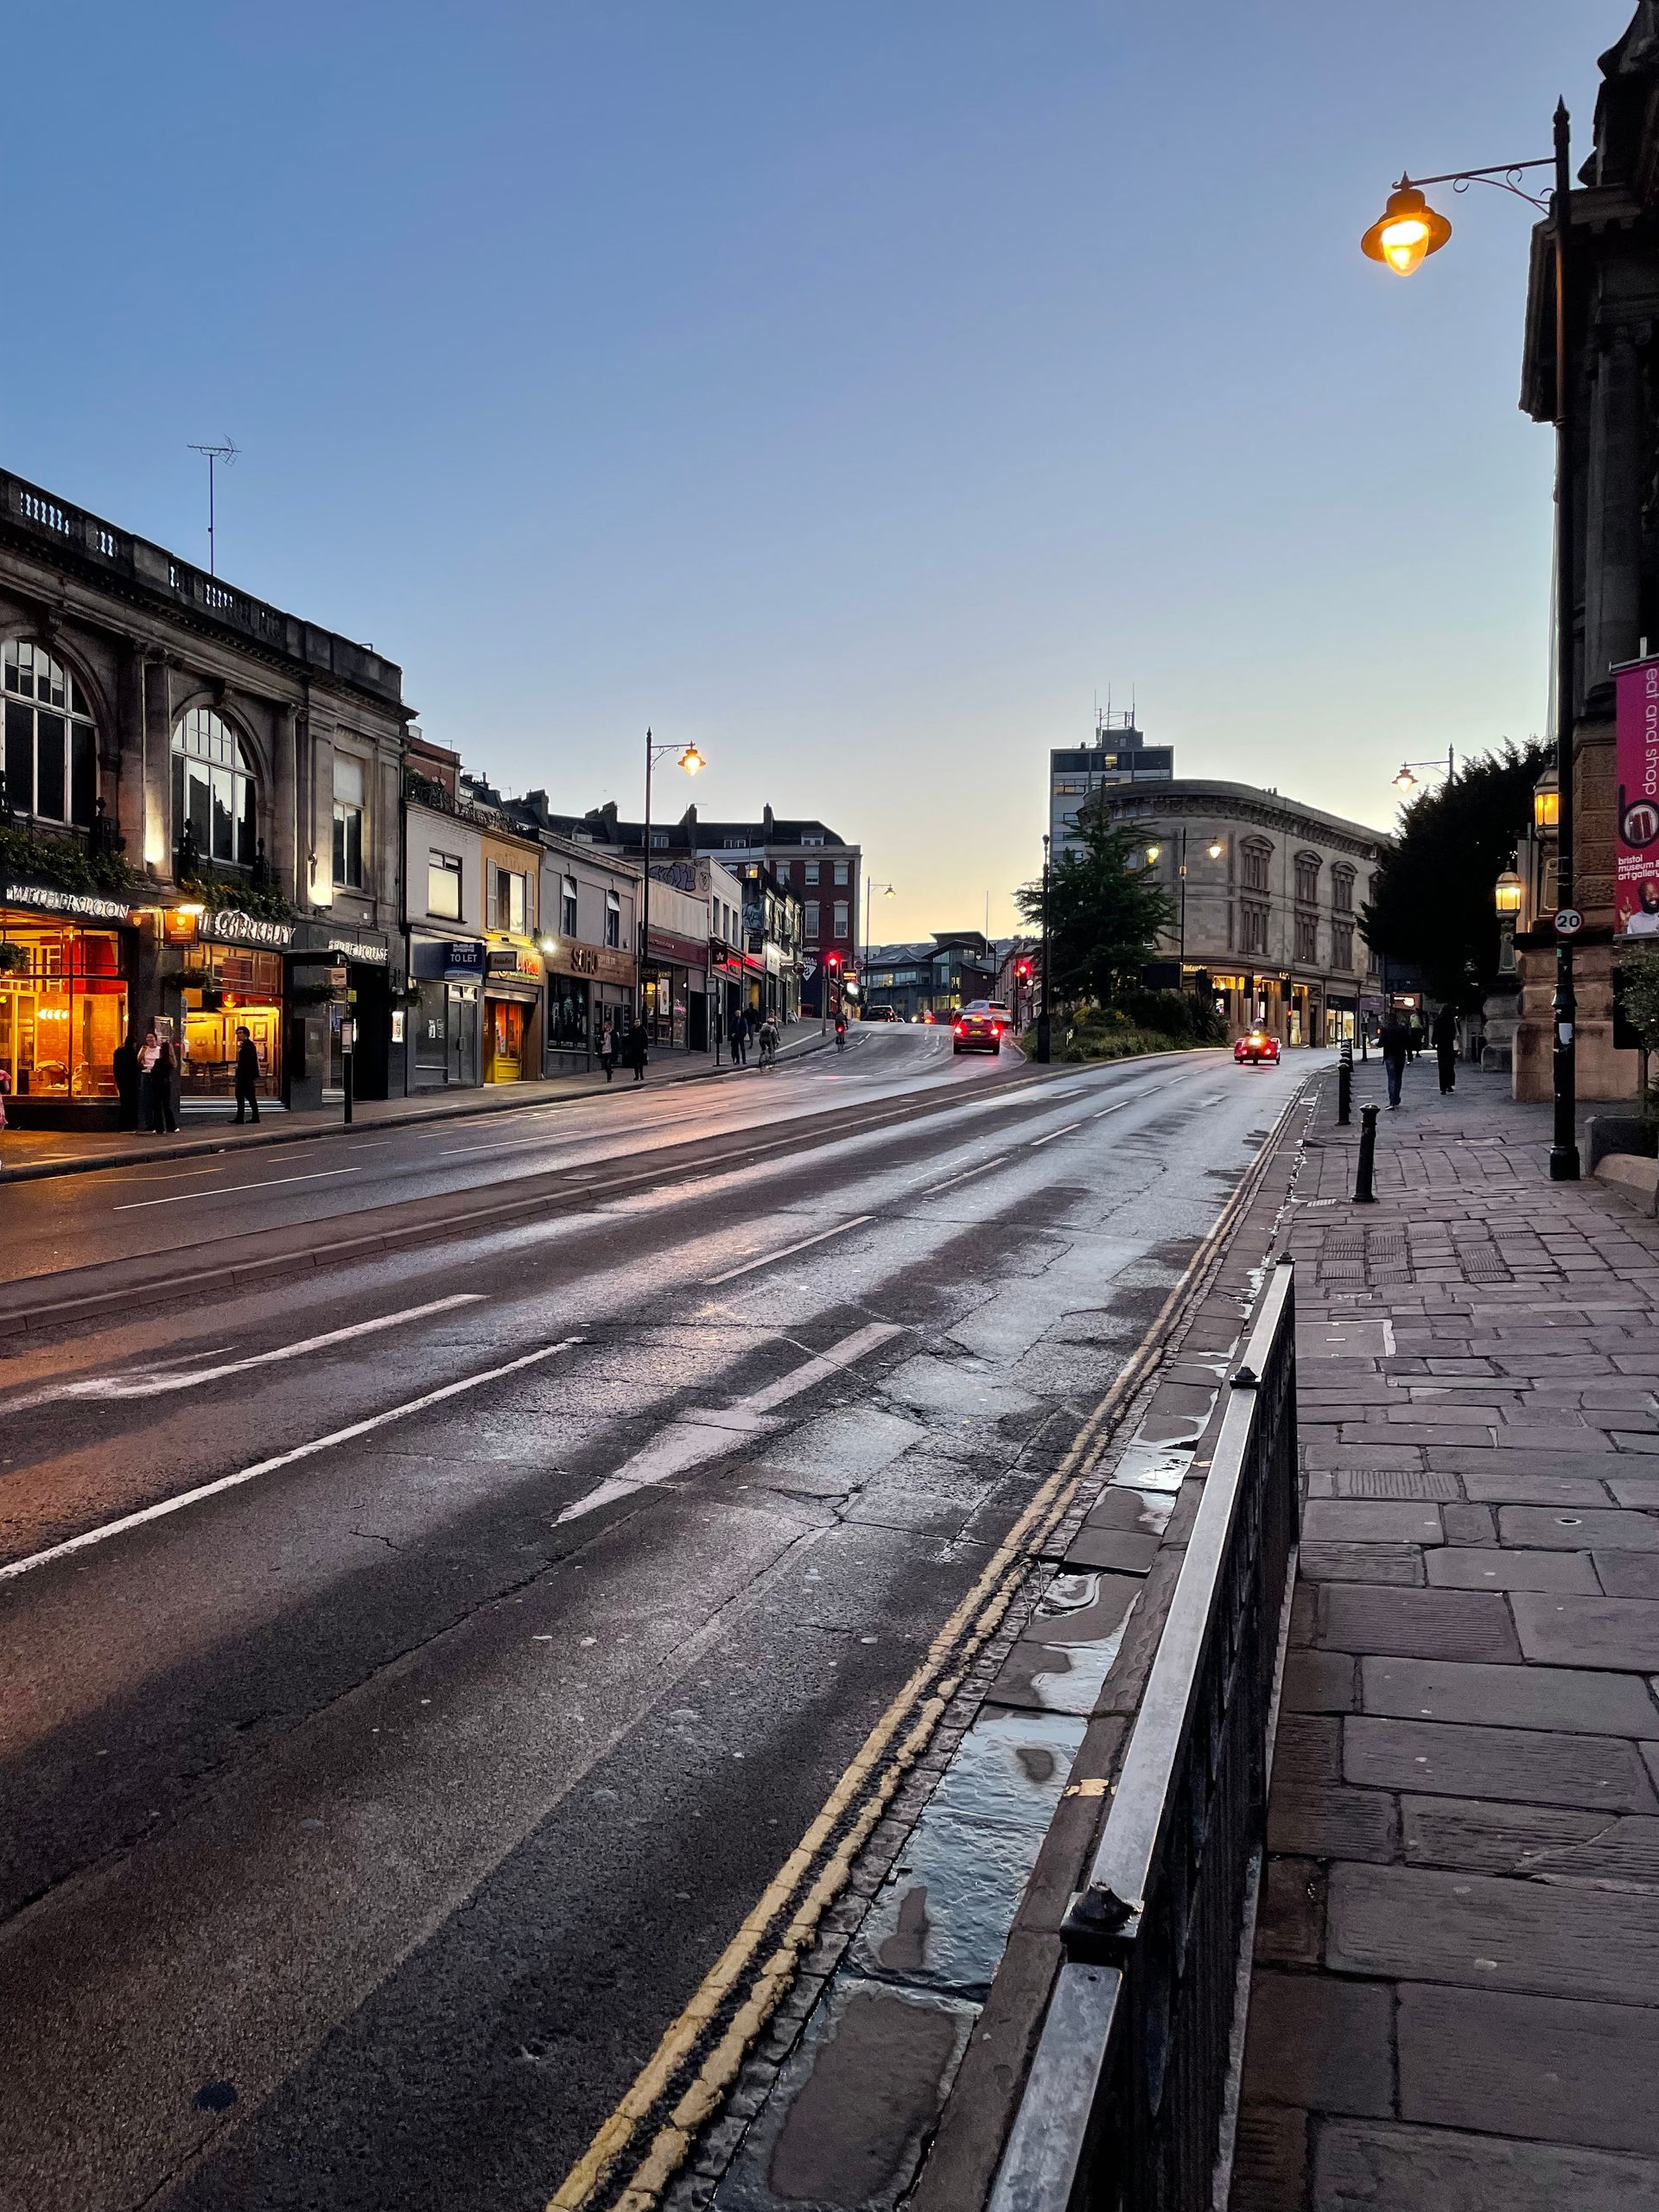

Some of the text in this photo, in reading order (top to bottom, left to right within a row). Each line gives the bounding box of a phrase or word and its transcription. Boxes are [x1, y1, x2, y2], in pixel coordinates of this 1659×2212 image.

[1642, 667, 1659, 796] eat and shop
[1618, 854, 1643, 866] bristol
[1618, 861, 1654, 873] museum
[1618, 871, 1630, 880] art
[12, 884, 130, 919] WETHERSPOON
[213, 910, 297, 944] BERKELEY
[1557, 915, 1580, 928] 20
[358, 944, 389, 961] HOUSE
[449, 953, 478, 963] TO LET
[571, 946, 598, 975] SOHO
